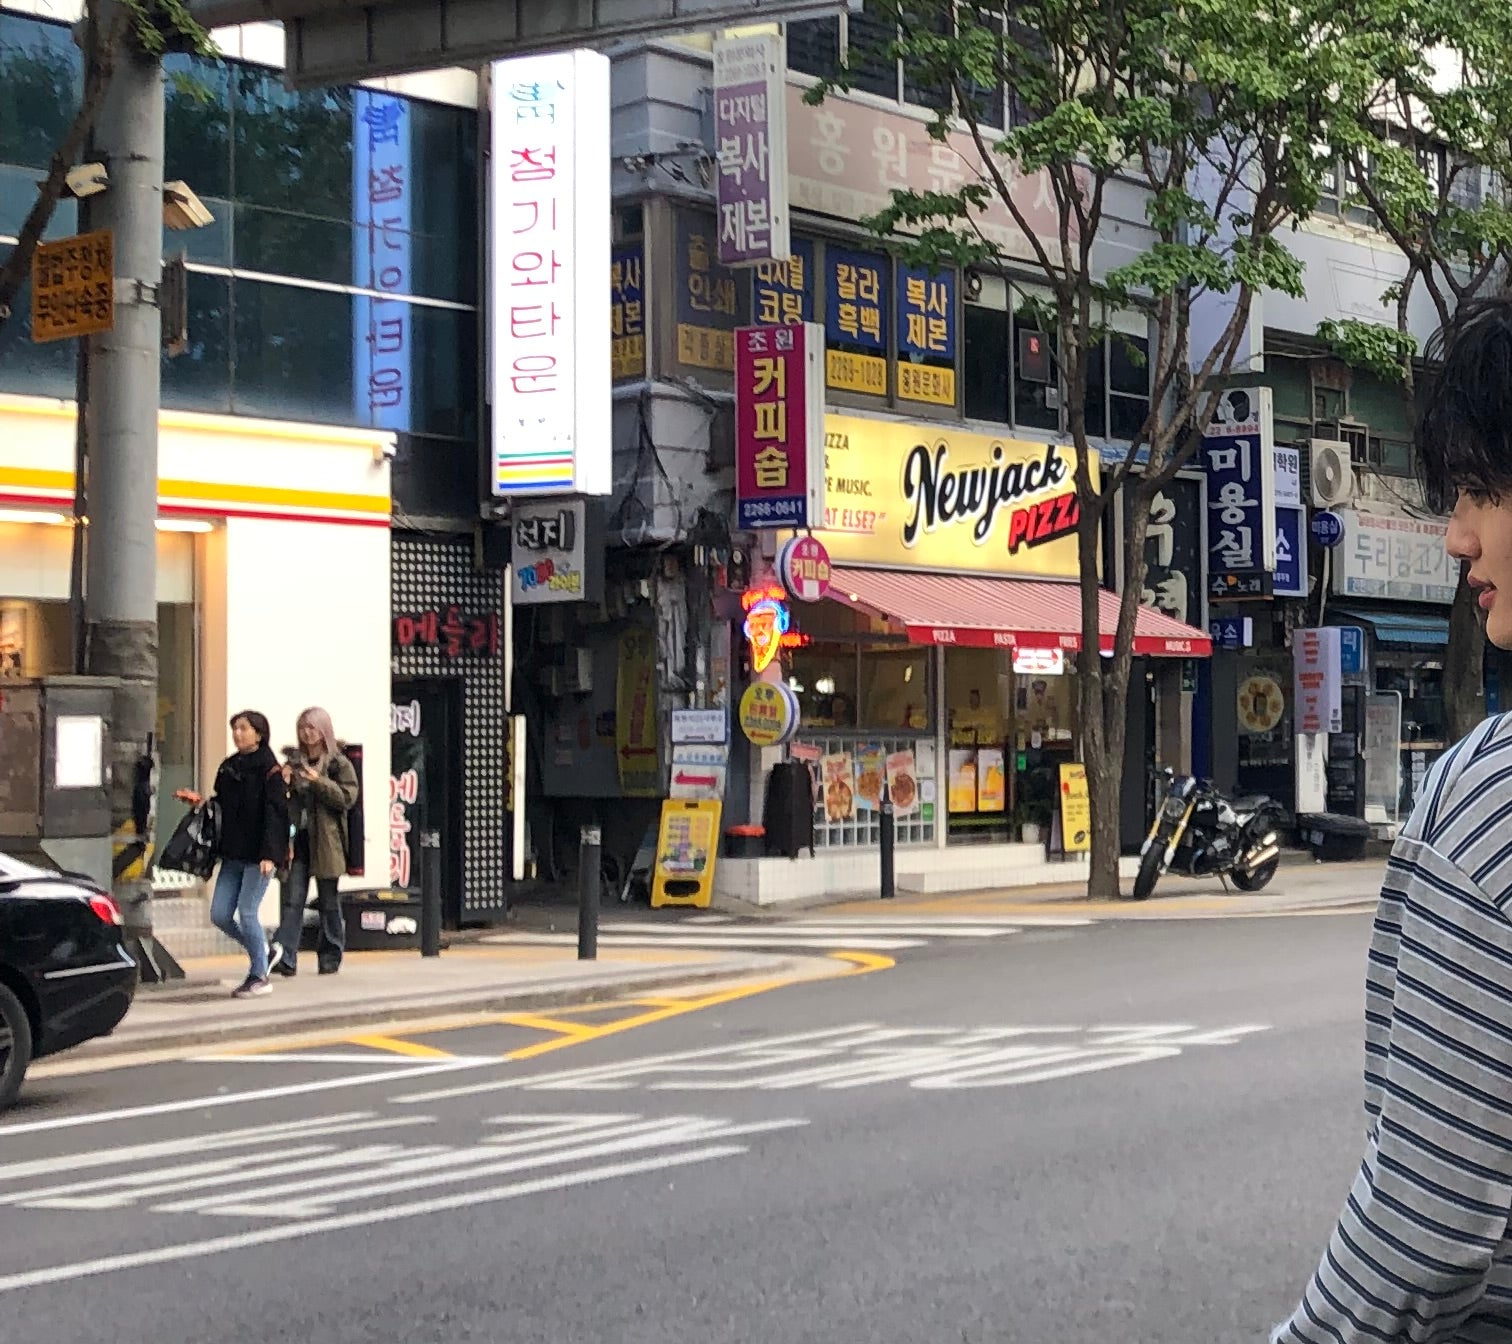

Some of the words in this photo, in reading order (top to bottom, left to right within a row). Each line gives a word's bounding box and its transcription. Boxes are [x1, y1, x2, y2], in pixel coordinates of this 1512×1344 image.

[719, 93, 767, 126] 디지털
[720, 131, 769, 185] 복사
[721, 197, 770, 252] 제본
[837, 263, 880, 306] 칼라
[906, 276, 948, 318] 복사
[759, 289, 803, 326] 코팅
[838, 303, 881, 344] 흑백
[748, 328, 795, 353] 초원
[906, 312, 947, 352] 제본
[753, 356, 790, 488] 커피숍
[904, 443, 1067, 544] Newjack
[1207, 440, 1259, 568] 미용실
